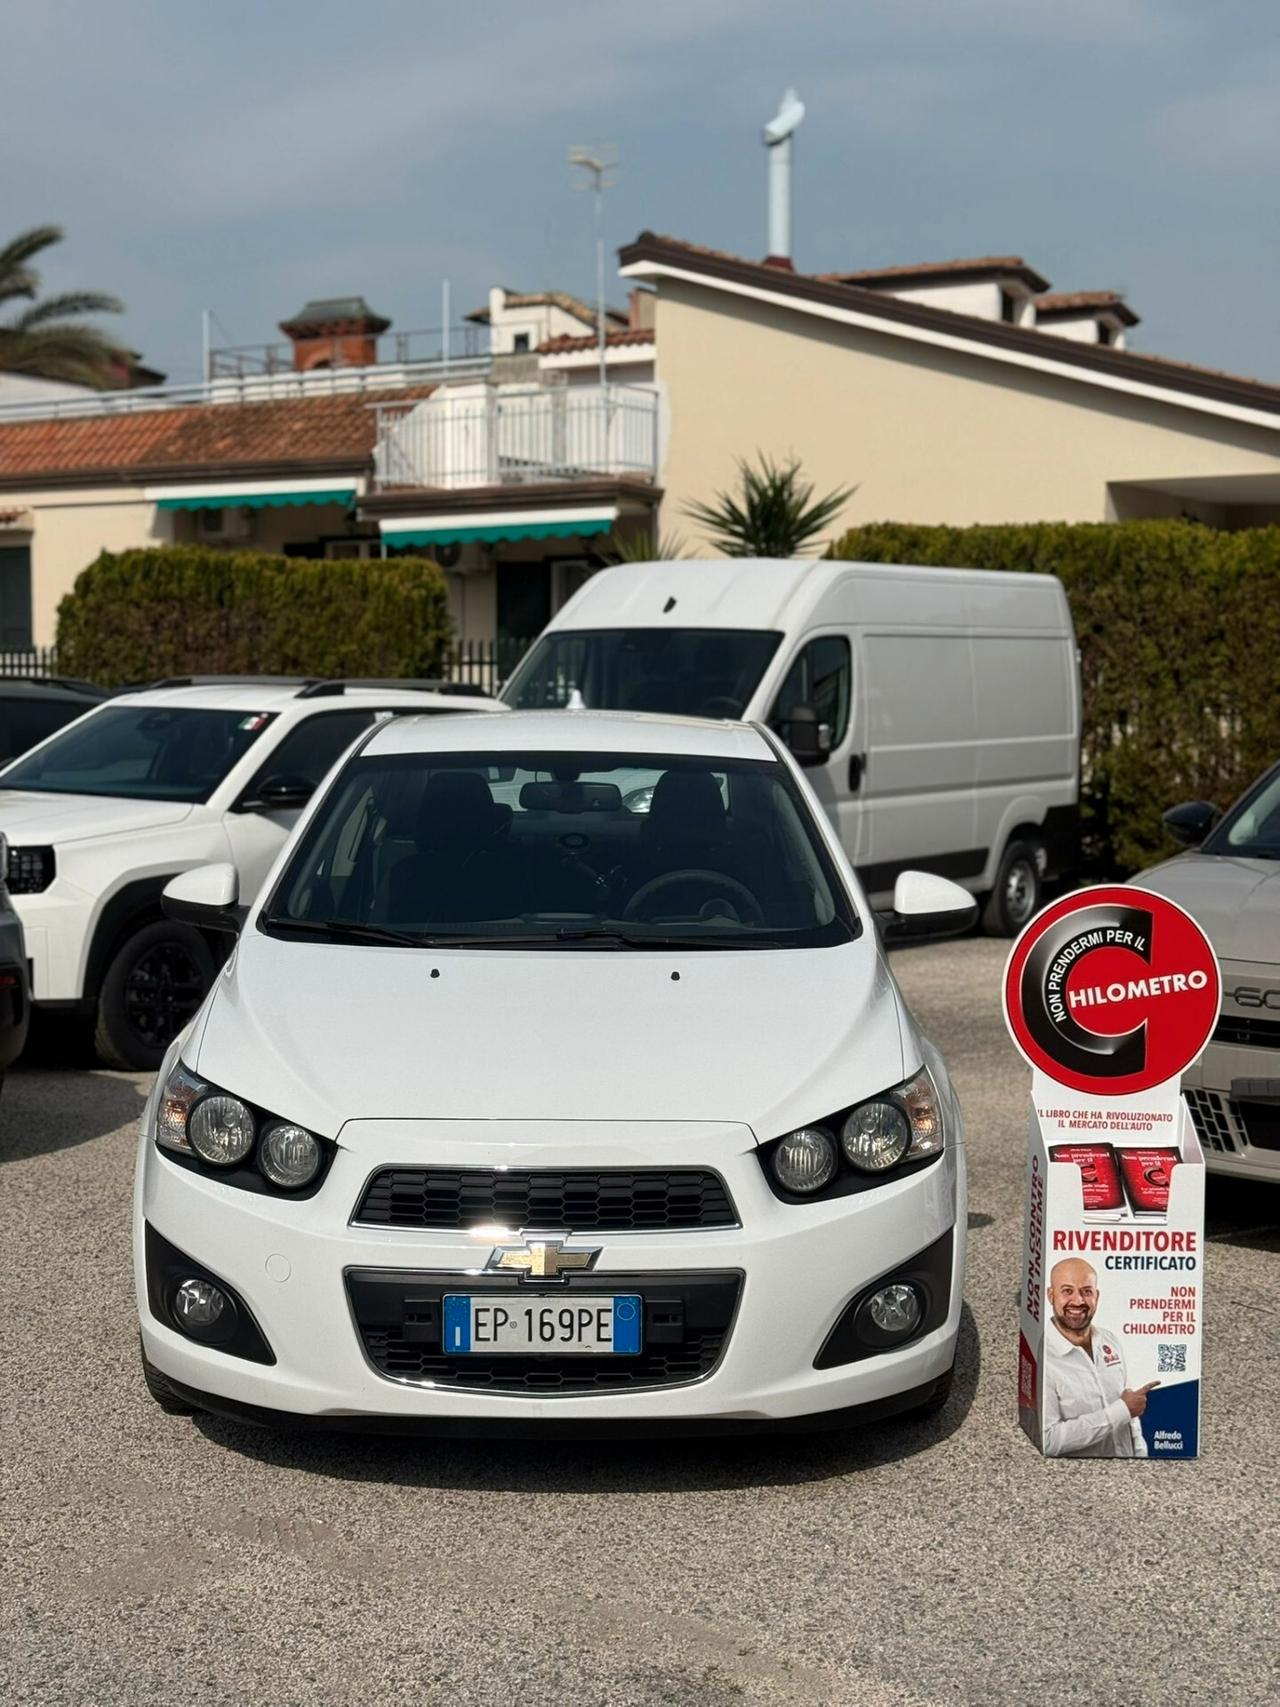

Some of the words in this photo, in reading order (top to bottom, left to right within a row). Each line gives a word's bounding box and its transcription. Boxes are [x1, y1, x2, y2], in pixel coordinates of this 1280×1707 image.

[1106, 930, 1134, 943] PER
[1134, 935, 1146, 951] IL
[1048, 931, 1104, 991] PRENDERMI
[1048, 995, 1066, 1022] NON
[1046, 1110, 1071, 1119] LIBRO
[1072, 1111, 1089, 1119] CHE
[1090, 1111, 1103, 1120] HA
[1106, 1112, 1173, 1122] RIVOLUZIONATO
[1058, 1120, 1066, 1128] IL
[1069, 1120, 1108, 1130] MERCATO
[1110, 1121, 1153, 1131] DELL'AUTO
[1029, 1155, 1038, 1254] CONTRO
[1034, 1177, 1044, 1277] INSIEME
[1053, 1230, 1197, 1252] RIVENDITORE
[1105, 1255, 1196, 1271] CERTIFICATO
[1026, 1261, 1036, 1315] NON
[1170, 1286, 1196, 1297] NON
[1033, 1284, 1041, 1323] MA
[1130, 1299, 1196, 1310] PRENDERMI
[1162, 1311, 1183, 1322] PER
[1186, 1311, 1196, 1322] IL
[474, 1308, 509, 1342] EP
[524, 1308, 613, 1342] 169PE
[1123, 1323, 1196, 1335] CHILOMETRO
[1154, 1430, 1182, 1440] Alfredo
[1154, 1440, 1183, 1450] Bellucci
